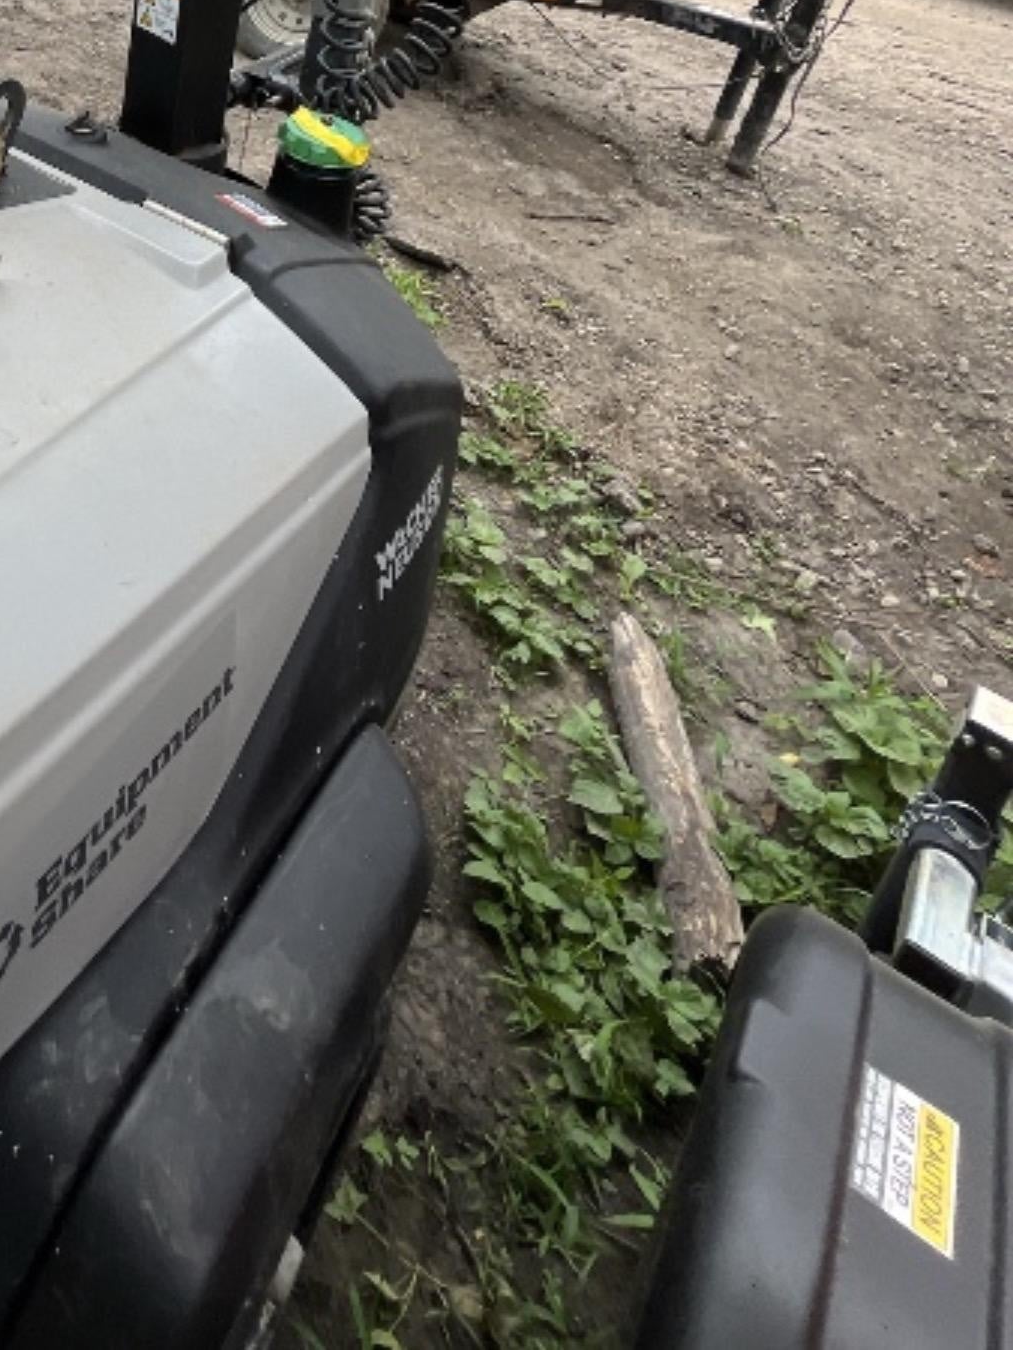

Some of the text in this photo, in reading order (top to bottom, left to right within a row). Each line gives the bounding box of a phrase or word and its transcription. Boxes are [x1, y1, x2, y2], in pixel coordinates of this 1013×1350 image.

[35, 666, 236, 914] Equipment
[30, 804, 147, 948] Share
[890, 1154, 912, 1206] STEP
[918, 1131, 946, 1236] CAUTION
